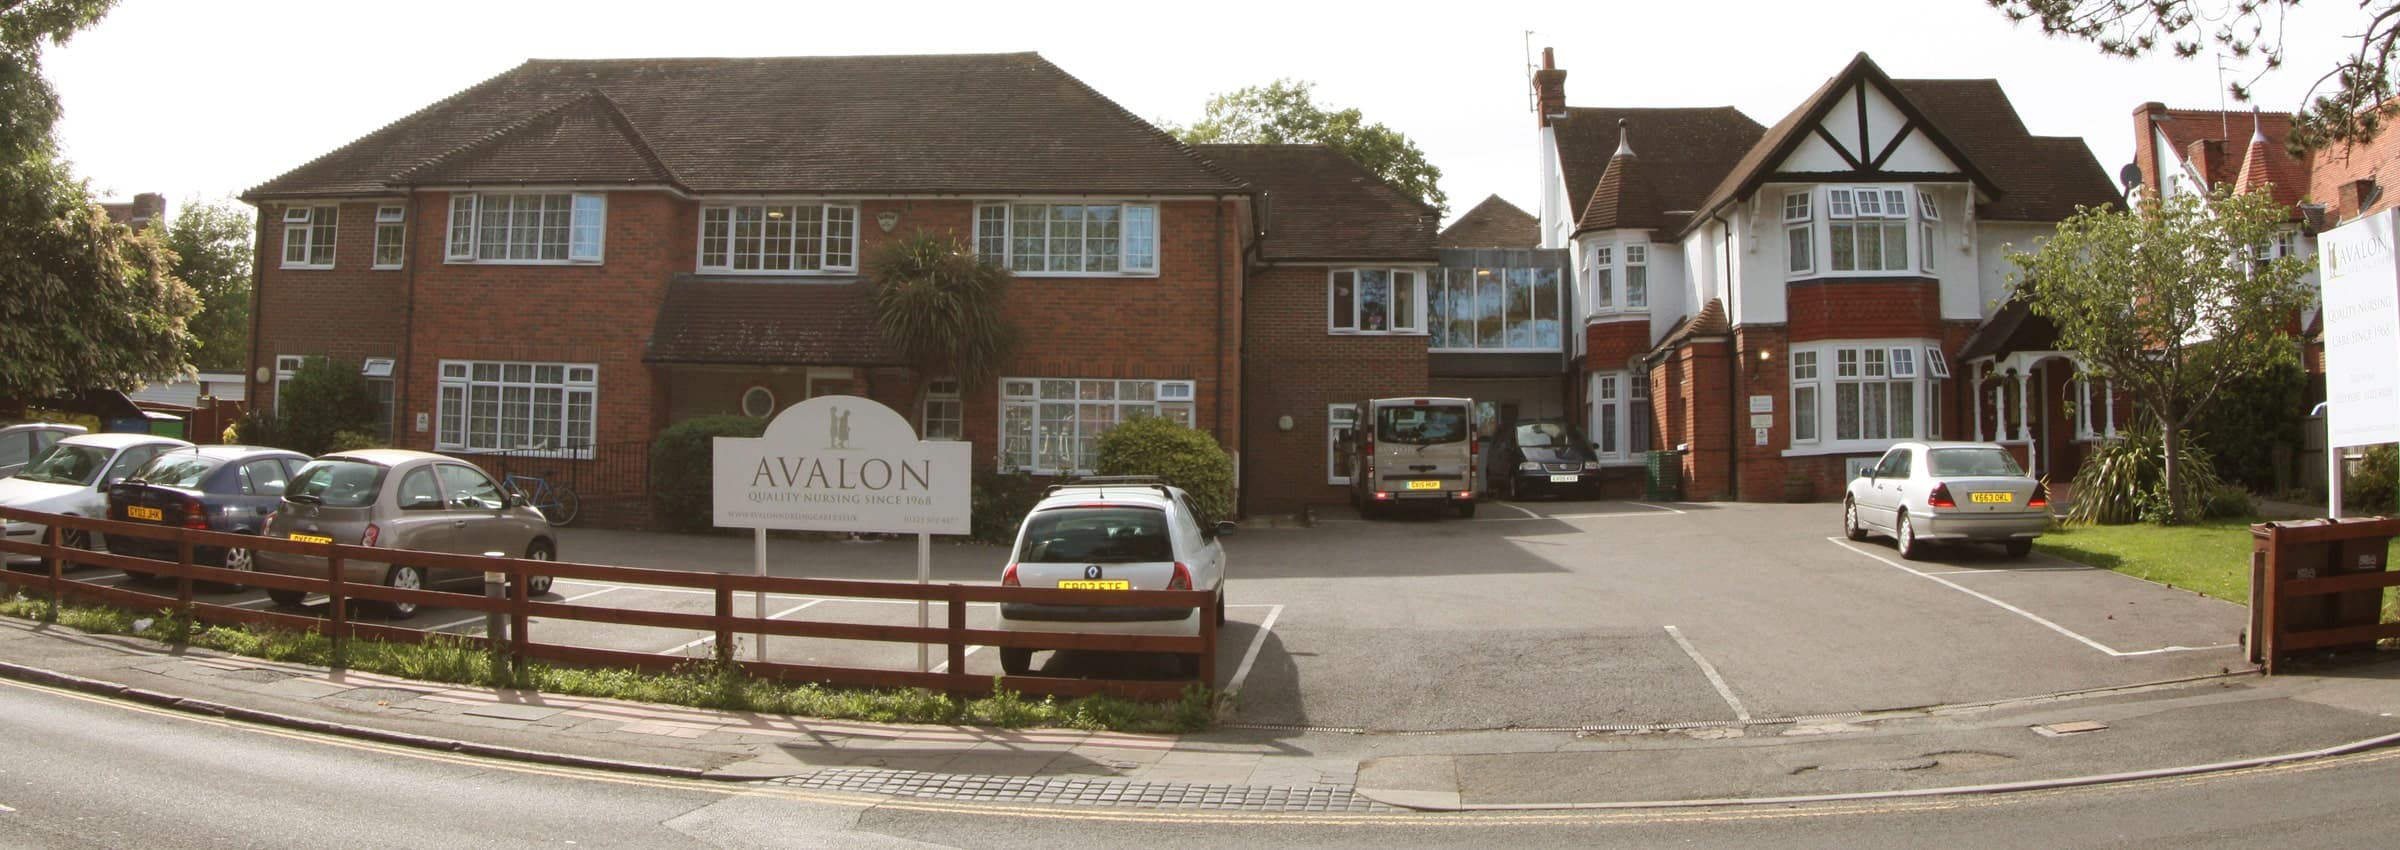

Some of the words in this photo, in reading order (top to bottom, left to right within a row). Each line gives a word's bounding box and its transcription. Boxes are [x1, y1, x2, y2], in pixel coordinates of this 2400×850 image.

[2340, 233, 2388, 265] AVALON
[751, 455, 931, 491] AVALON
[748, 491, 801, 503] QUALITY
[804, 493, 862, 504] NURSING
[865, 494, 902, 505] SINCE
[906, 495, 932, 505] 1968
